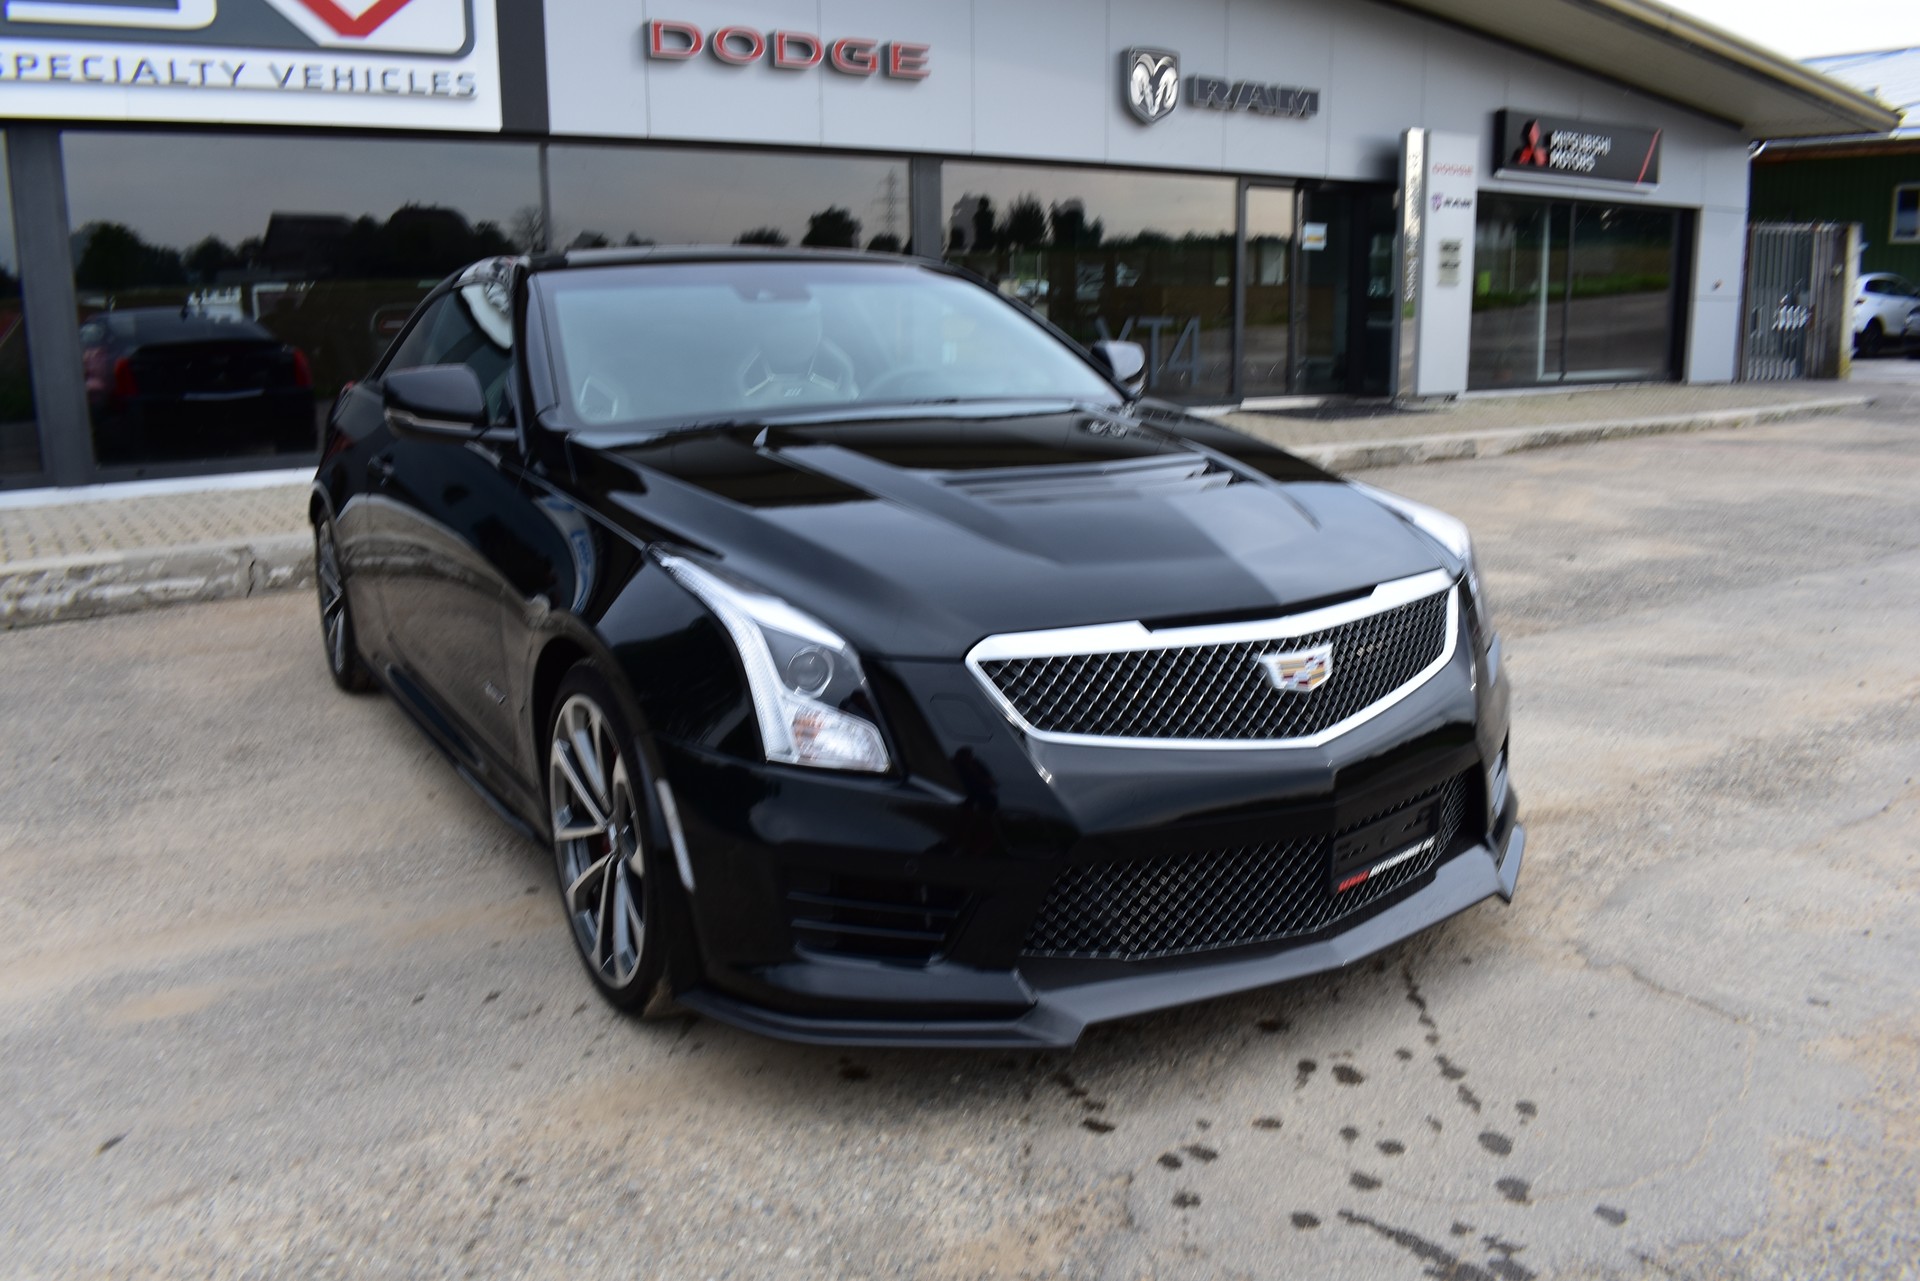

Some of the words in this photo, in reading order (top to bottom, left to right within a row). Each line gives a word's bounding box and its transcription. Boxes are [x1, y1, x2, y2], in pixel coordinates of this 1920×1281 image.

[649, 18, 932, 78] DODGE
[0, 52, 246, 87] PECIALTY
[269, 61, 477, 97] VEHICLES
[1186, 73, 1320, 120] RAM
[1549, 149, 1597, 172] MOTORS
[1551, 129, 1612, 156] MITSUBISHI
